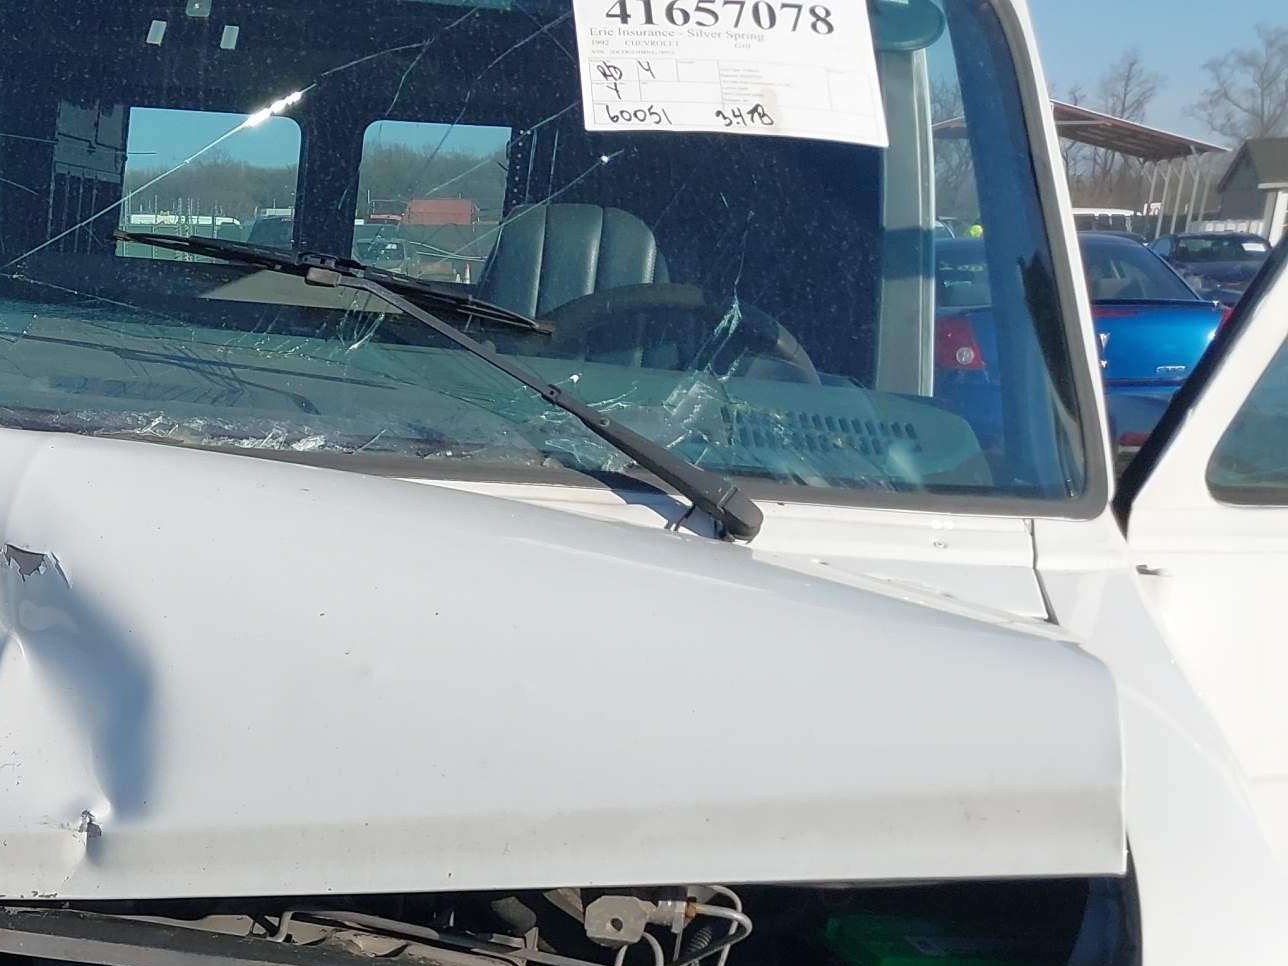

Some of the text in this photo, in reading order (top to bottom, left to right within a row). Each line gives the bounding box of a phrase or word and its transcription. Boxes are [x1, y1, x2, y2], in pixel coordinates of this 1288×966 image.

[605, 0, 835, 35] 41657078
[618, 27, 676, 38] Insurance
[687, 29, 721, 39] Silver
[725, 30, 766, 44] Spring
[605, 104, 673, 125] 60051
